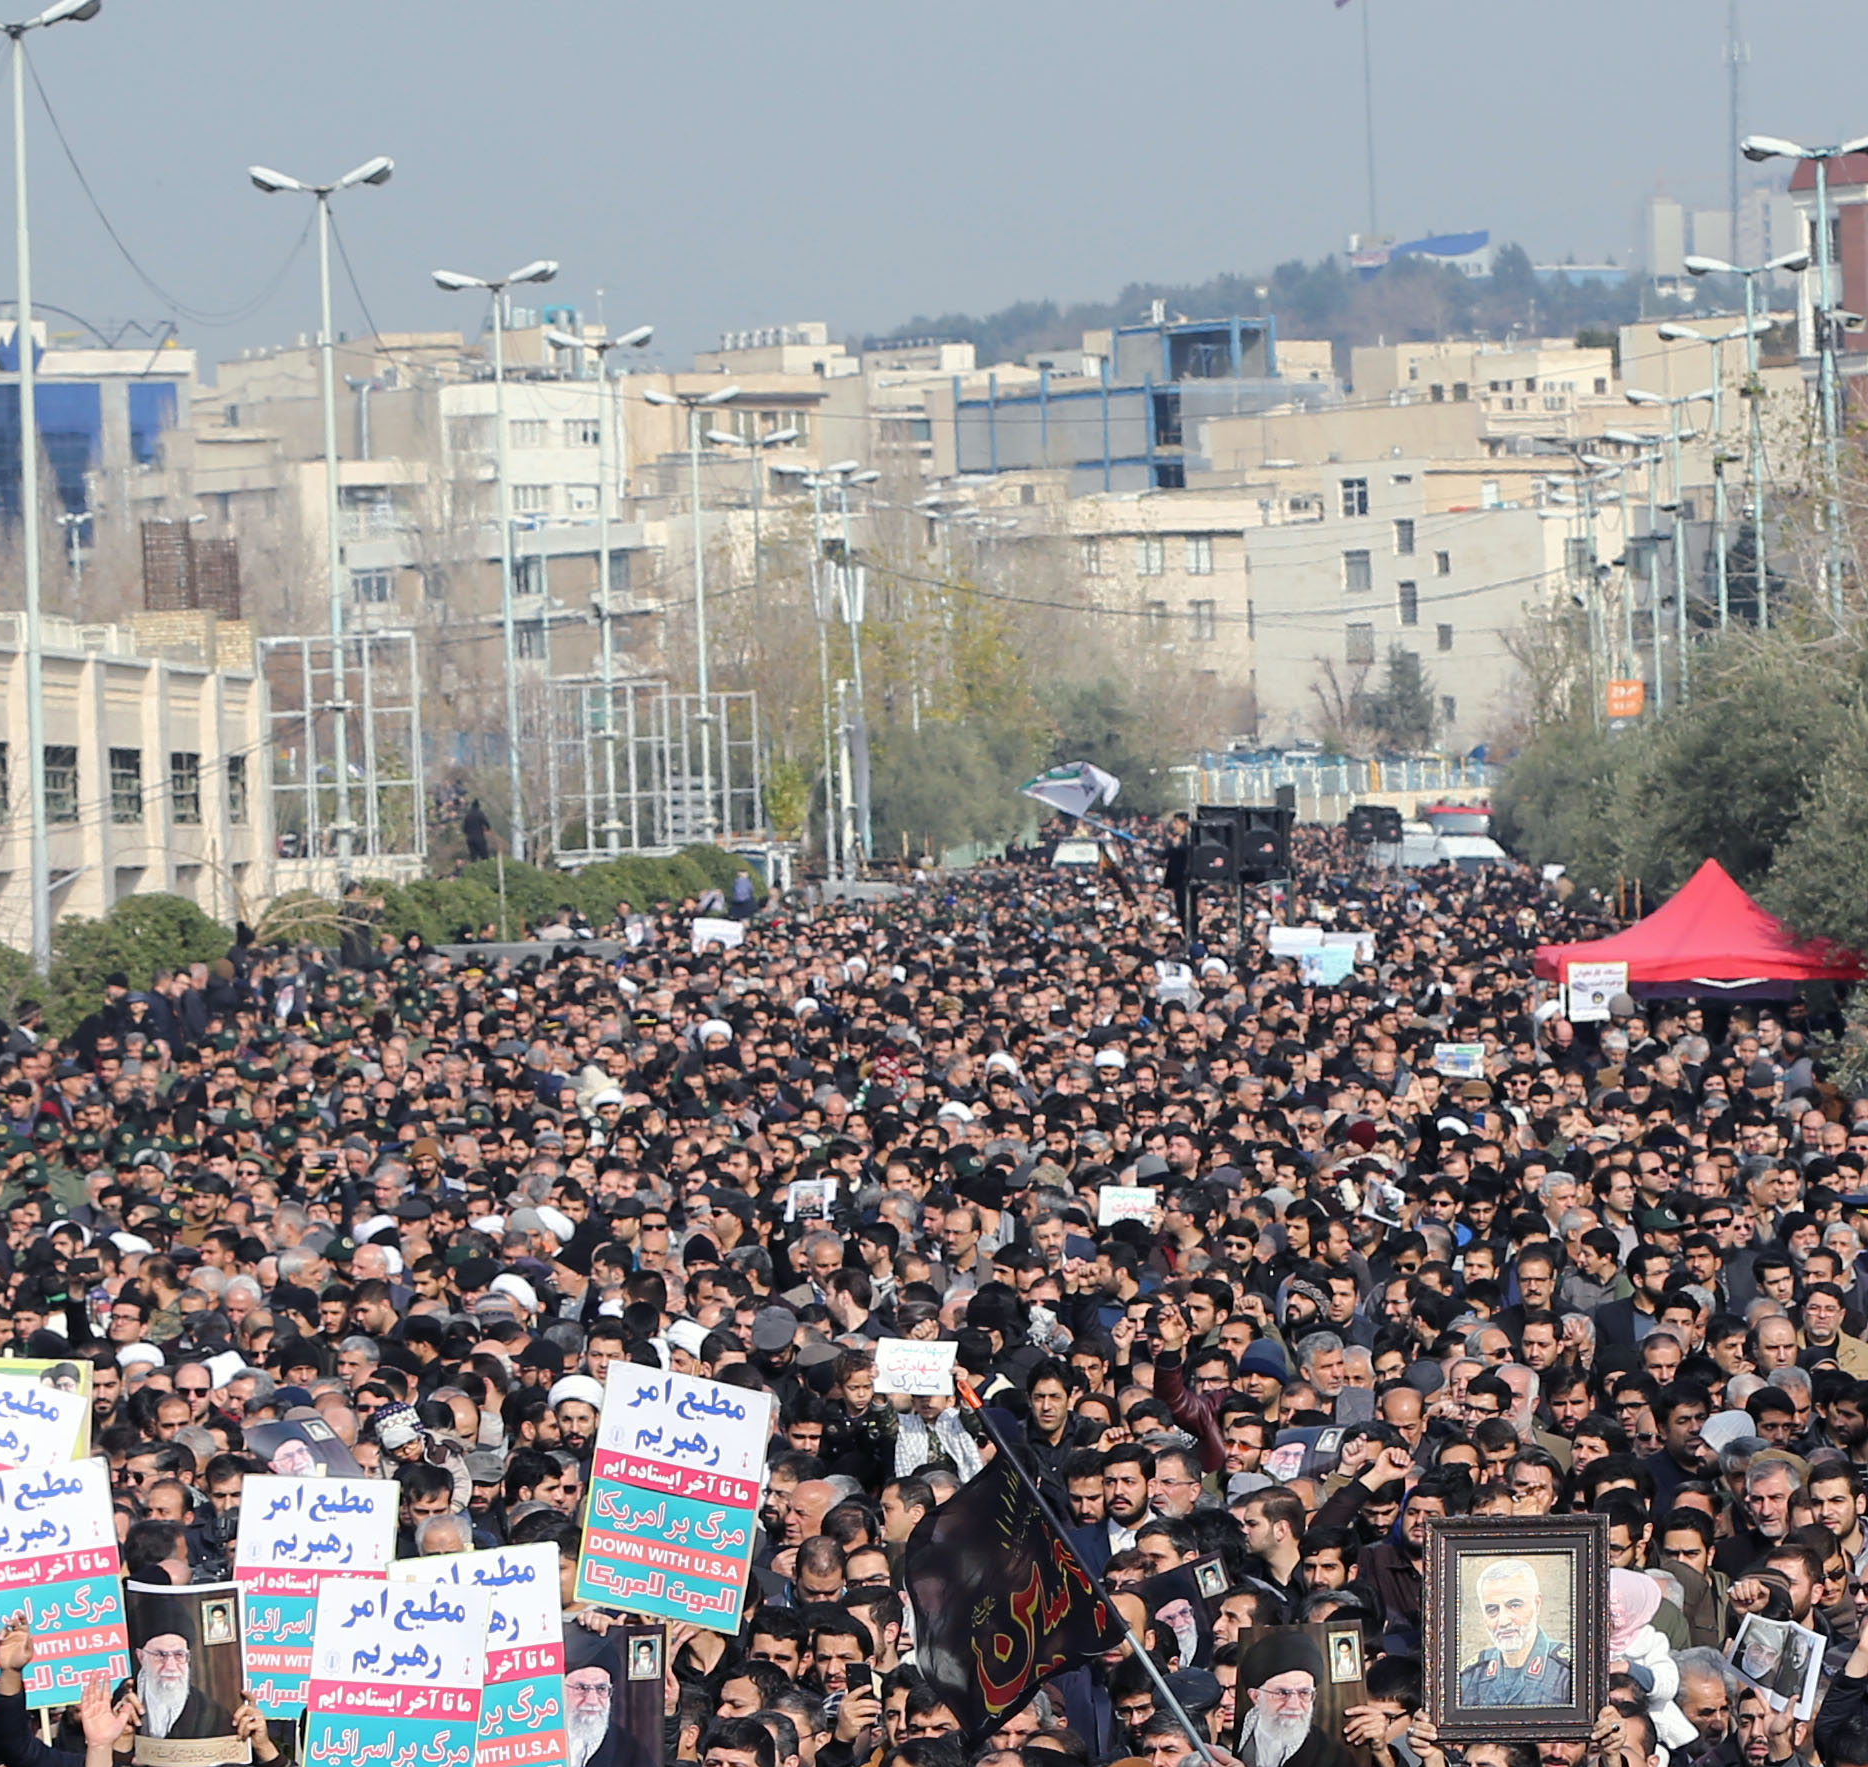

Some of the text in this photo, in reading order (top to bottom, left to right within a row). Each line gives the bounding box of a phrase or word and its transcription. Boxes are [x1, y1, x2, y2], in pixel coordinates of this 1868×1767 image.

[628, 1377, 746, 1421] مطیع امر
[635, 1426, 720, 1466] رهبریم
[14, 1470, 84, 1511] مطیع
[602, 1457, 749, 1501] ما تا آخر ایستاده ایم
[262, 1485, 374, 1521] مطیع امر
[595, 1488, 745, 1550] مرگ بر امریکا
[79, 1553, 92, 1572] تا
[94, 1550, 110, 1569] ما
[272, 1531, 353, 1564] رهبریم
[589, 1535, 738, 1579] DOWN WITH U.S.A
[46, 1553, 74, 1582] آخر
[267, 1573, 318, 1594] ایستاده
[65, 1585, 117, 1623] مرگ
[585, 1559, 736, 1614] الموت لامریکا
[36, 1602, 61, 1632] بر
[341, 1587, 388, 1628] امر
[395, 1589, 466, 1630] مطیع
[75, 1631, 122, 1650] U.S.A
[540, 1649, 555, 1667] ما
[247, 1653, 311, 1667] OWN WIT
[352, 1643, 442, 1678] رهبریم
[493, 1651, 520, 1680] آخر
[317, 1686, 472, 1715] ما تا آخر ایستاده ایم
[479, 1685, 559, 1735] مرگ بر
[310, 1727, 395, 1767] اسرائیل
[514, 1738, 560, 1758] U.S.A
